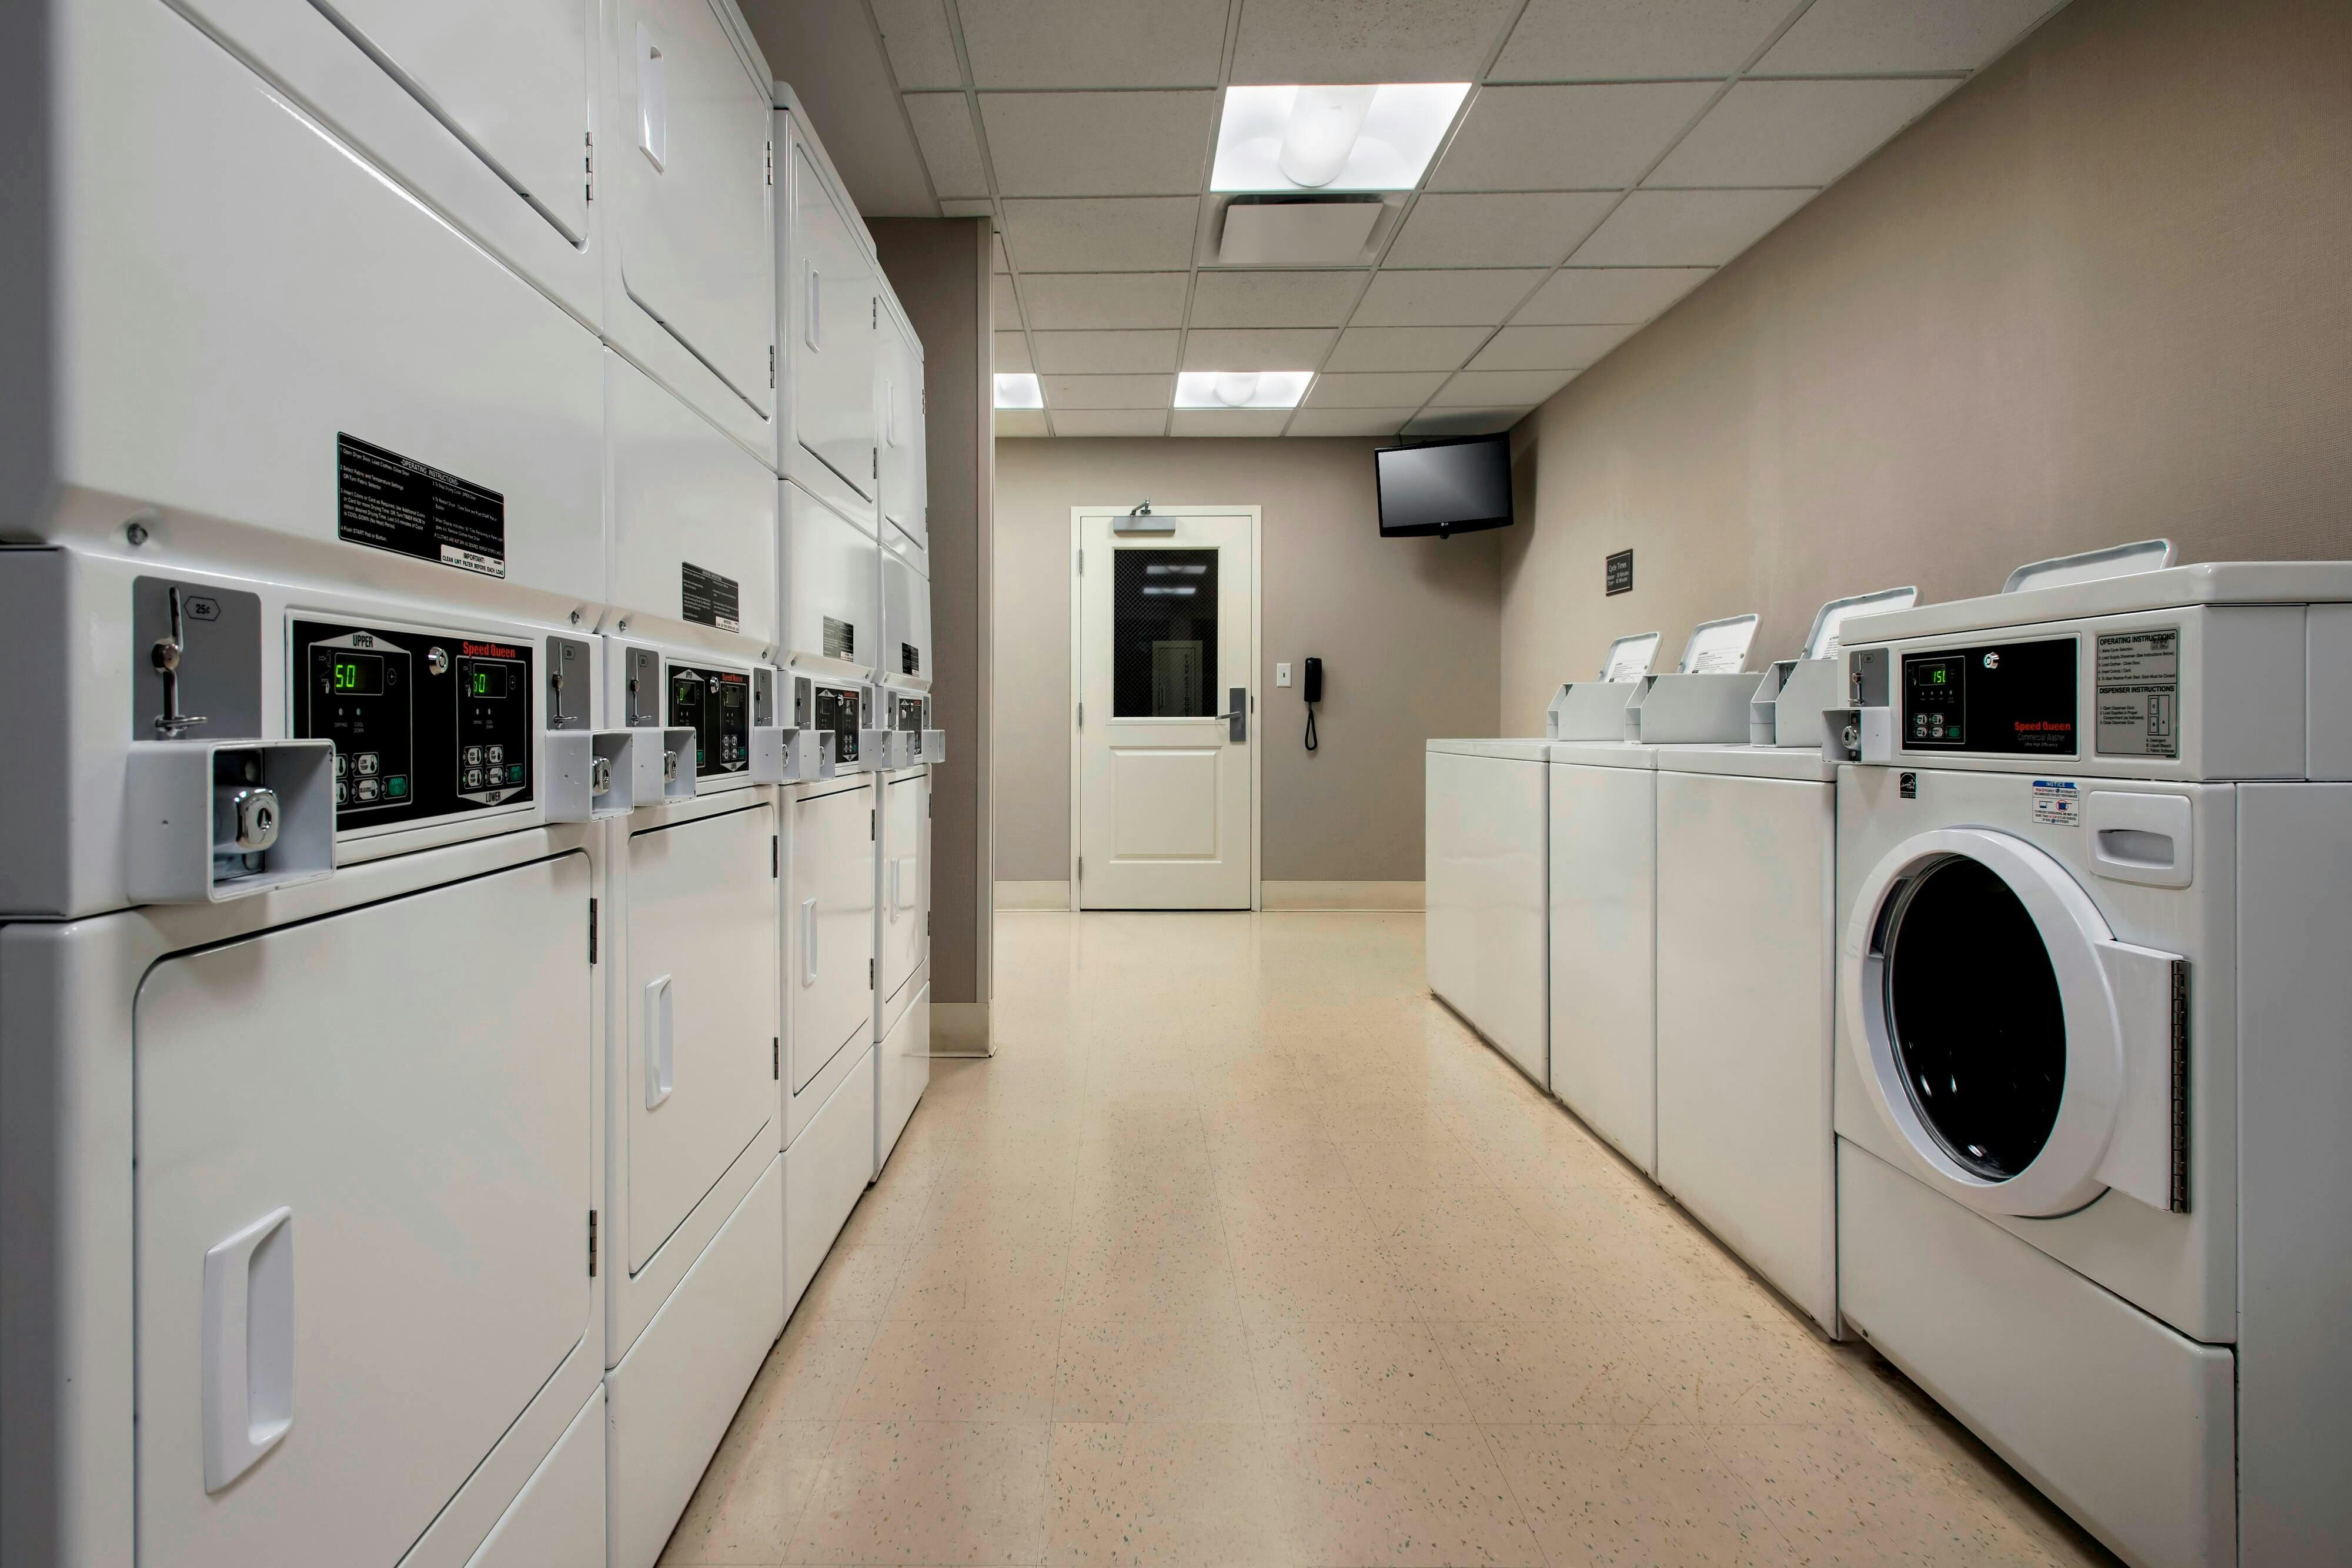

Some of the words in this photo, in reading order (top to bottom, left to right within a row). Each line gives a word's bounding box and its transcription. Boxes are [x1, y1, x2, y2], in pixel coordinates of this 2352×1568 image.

[1609, 564, 1617, 574] Cycle
[353, 634, 373, 648] UPPER
[2100, 637, 2131, 646] OPERATING
[2132, 633, 2175, 643] INSTRUCTIONS
[463, 641, 489, 658] Speed
[490, 644, 515, 658] Queen
[336, 665, 355, 688] 50
[2014, 721, 2041, 733] Speed
[2043, 721, 2071, 731] Queen
[486, 791, 501, 803] LOWER
